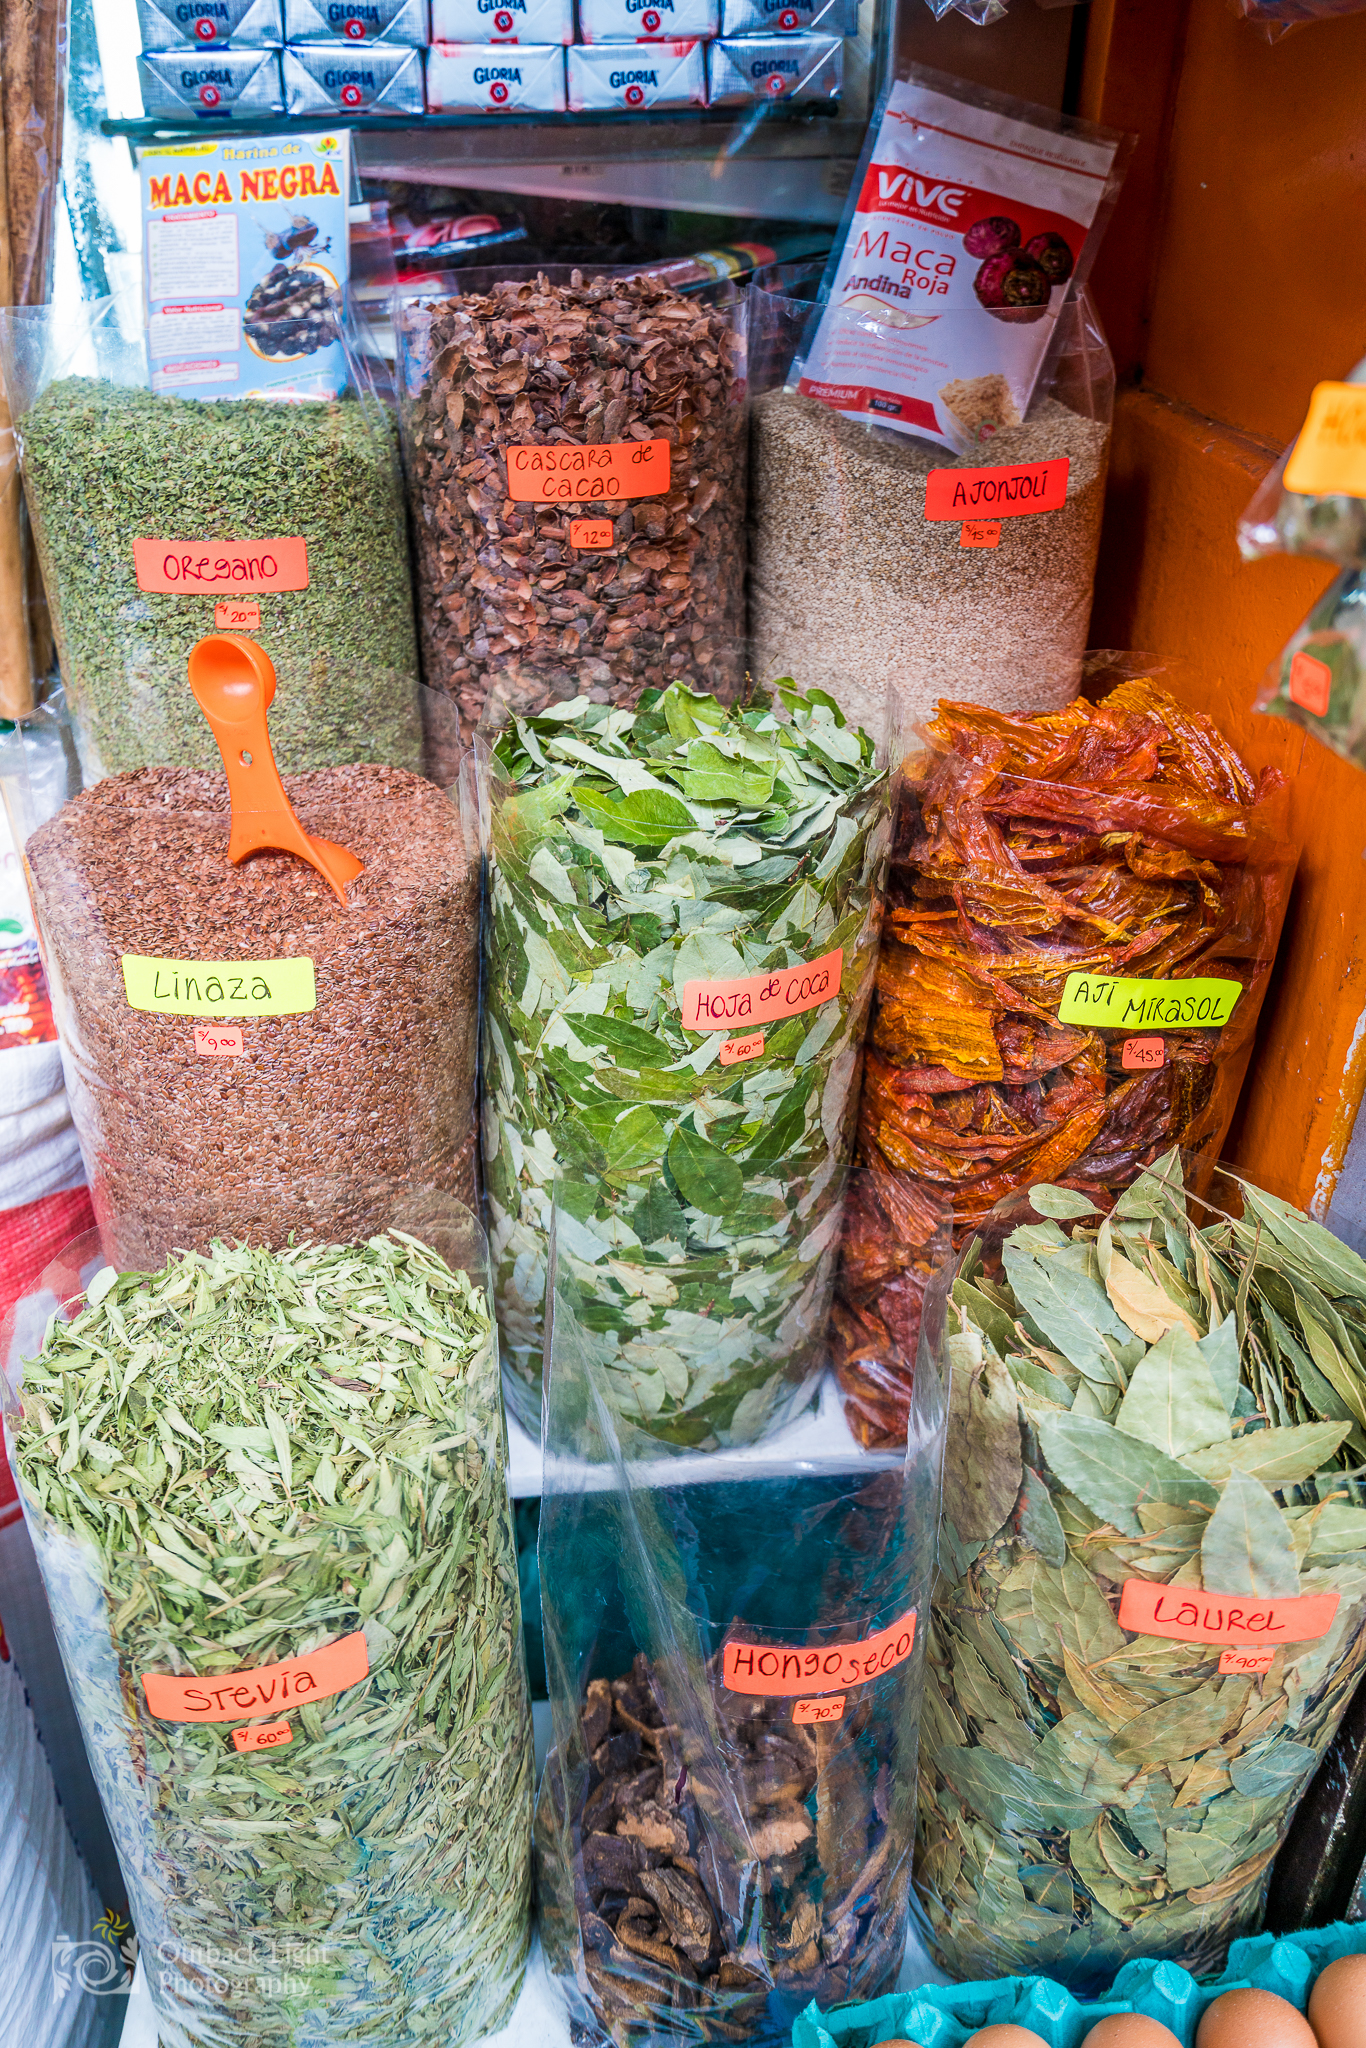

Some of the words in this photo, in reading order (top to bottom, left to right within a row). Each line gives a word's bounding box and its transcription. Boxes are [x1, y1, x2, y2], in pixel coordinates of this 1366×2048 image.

[175, 3, 231, 22] GLORIA
[328, 3, 380, 25] GLORIA
[181, 68, 233, 88] GLORIA
[473, 66, 523, 85] GLORIA
[610, 69, 659, 87] GLORIA
[751, 60, 800, 78] GLORIA
[324, 70, 376, 89] GLORIA
[222, 146, 279, 161] Harina
[281, 143, 302, 156] de
[147, 170, 233, 211] MACA
[239, 161, 341, 203] NEGRA
[853, 231, 957, 277] Maca
[842, 275, 912, 299] Andina
[901, 268, 949, 296] Roja
[808, 385, 860, 400] PREMIUM
[632, 445, 655, 464] de
[154, 971, 272, 1002] Linaza
[760, 979, 781, 1001] de
